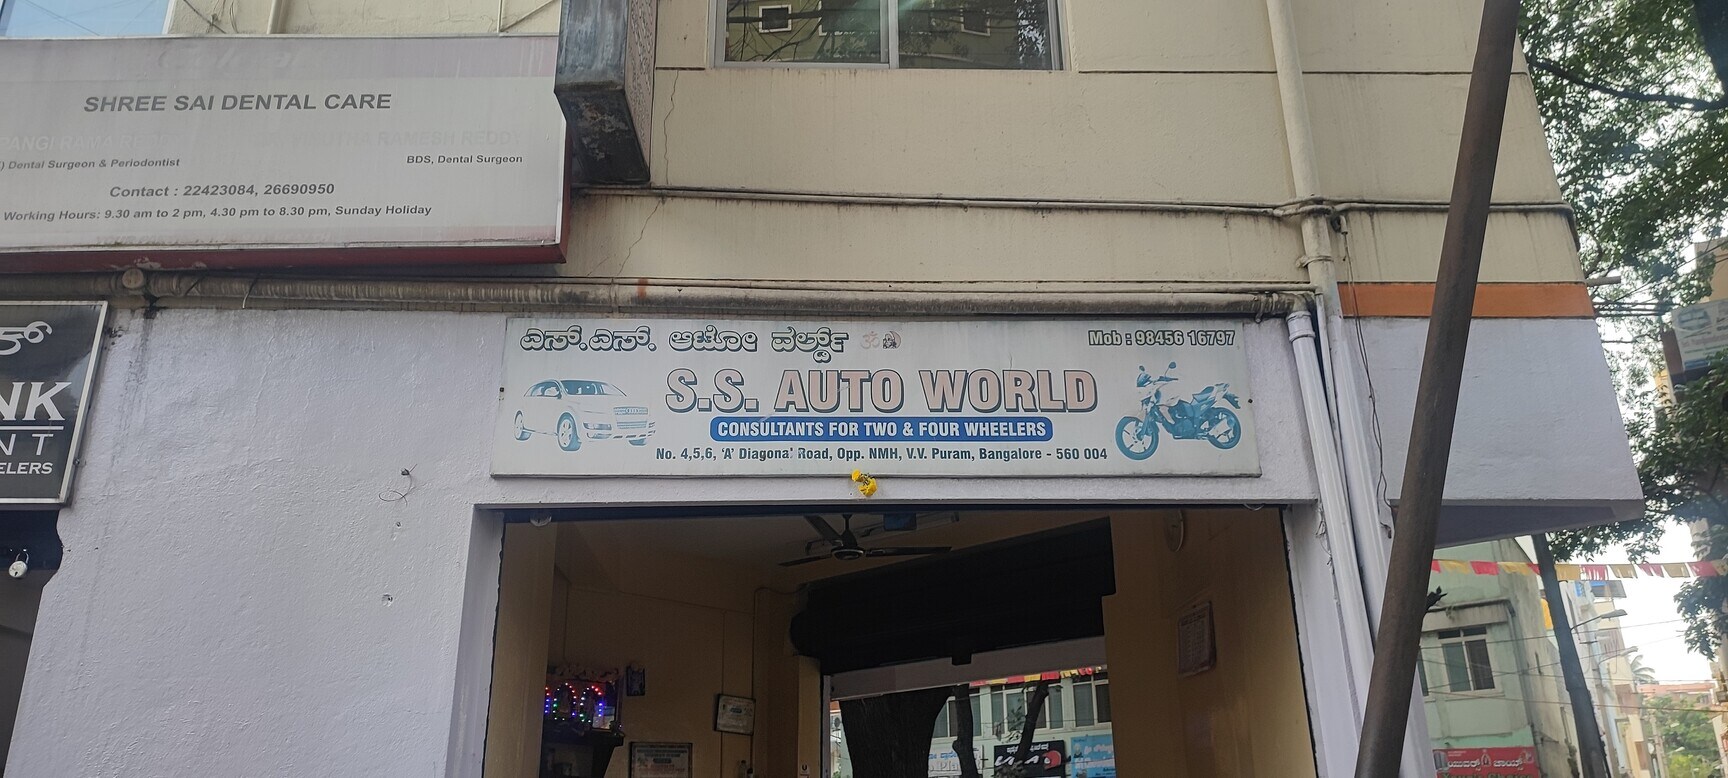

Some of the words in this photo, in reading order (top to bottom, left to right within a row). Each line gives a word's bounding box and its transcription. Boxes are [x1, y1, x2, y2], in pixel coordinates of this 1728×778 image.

[84, 95, 167, 112] SHREE
[173, 95, 214, 111] SAI
[221, 94, 317, 111] DENTAL
[324, 94, 392, 110] CARE
[59, 135, 114, 150] RAMA
[377, 131, 456, 146] RAMESH
[461, 130, 522, 145] REDDY
[8, 161, 45, 169] Dental
[47, 160, 95, 171] Surgeon
[99, 160, 107, 168] &
[110, 159, 181, 168] Periodontist
[406, 155, 434, 165] BDS,
[437, 155, 473, 164] Dental
[476, 154, 523, 165] Surgeon
[109, 186, 170, 198] Contact
[183, 185, 259, 198] 22423084,
[263, 183, 335, 195] 26690950
[3, 210, 55, 222] Working
[59, 210, 100, 220] Hours:
[104, 209, 130, 219] 9.30
[133, 211, 152, 219] am
[156, 209, 168, 218] to
[172, 208, 180, 218] 2
[183, 210, 207, 220] pm,
[210, 208, 236, 218] 4.30
[239, 210, 259, 220] pm
[263, 208, 275, 217] to
[279, 207, 305, 216] 8.30
[308, 209, 331, 219] pm,
[335, 206, 382, 217] Sunday
[385, 205, 432, 216] Holiday
[668, 325, 758, 352] ಆಟೋ
[1088, 330, 1122, 346] Mob
[1125, 332, 1133, 346] :
[1135, 330, 1184, 346] 98456
[1187, 330, 1236, 346] 16797
[665, 368, 759, 413] S.S.
[774, 368, 904, 413] AUTO
[918, 368, 1098, 413] WORLD
[717, 421, 824, 437] CONSULTANTS
[828, 421, 859, 437] FOR
[863, 421, 897, 437] TWO
[902, 421, 914, 437] &
[919, 421, 960, 437] FOUR
[964, 421, 1047, 437] WHEELERS
[656, 448, 676, 460] No.
[680, 448, 717, 461] 4,5,6,
[798, 448, 832, 462] Road,
[837, 448, 865, 462] Opp.
[869, 448, 902, 461] NMH,
[906, 448, 928, 460] V.V.
[932, 448, 975, 461] Puram,
[979, 447, 1042, 462] Bangalore
[1056, 448, 1080, 460] 560
[1084, 448, 1108, 460] 004
